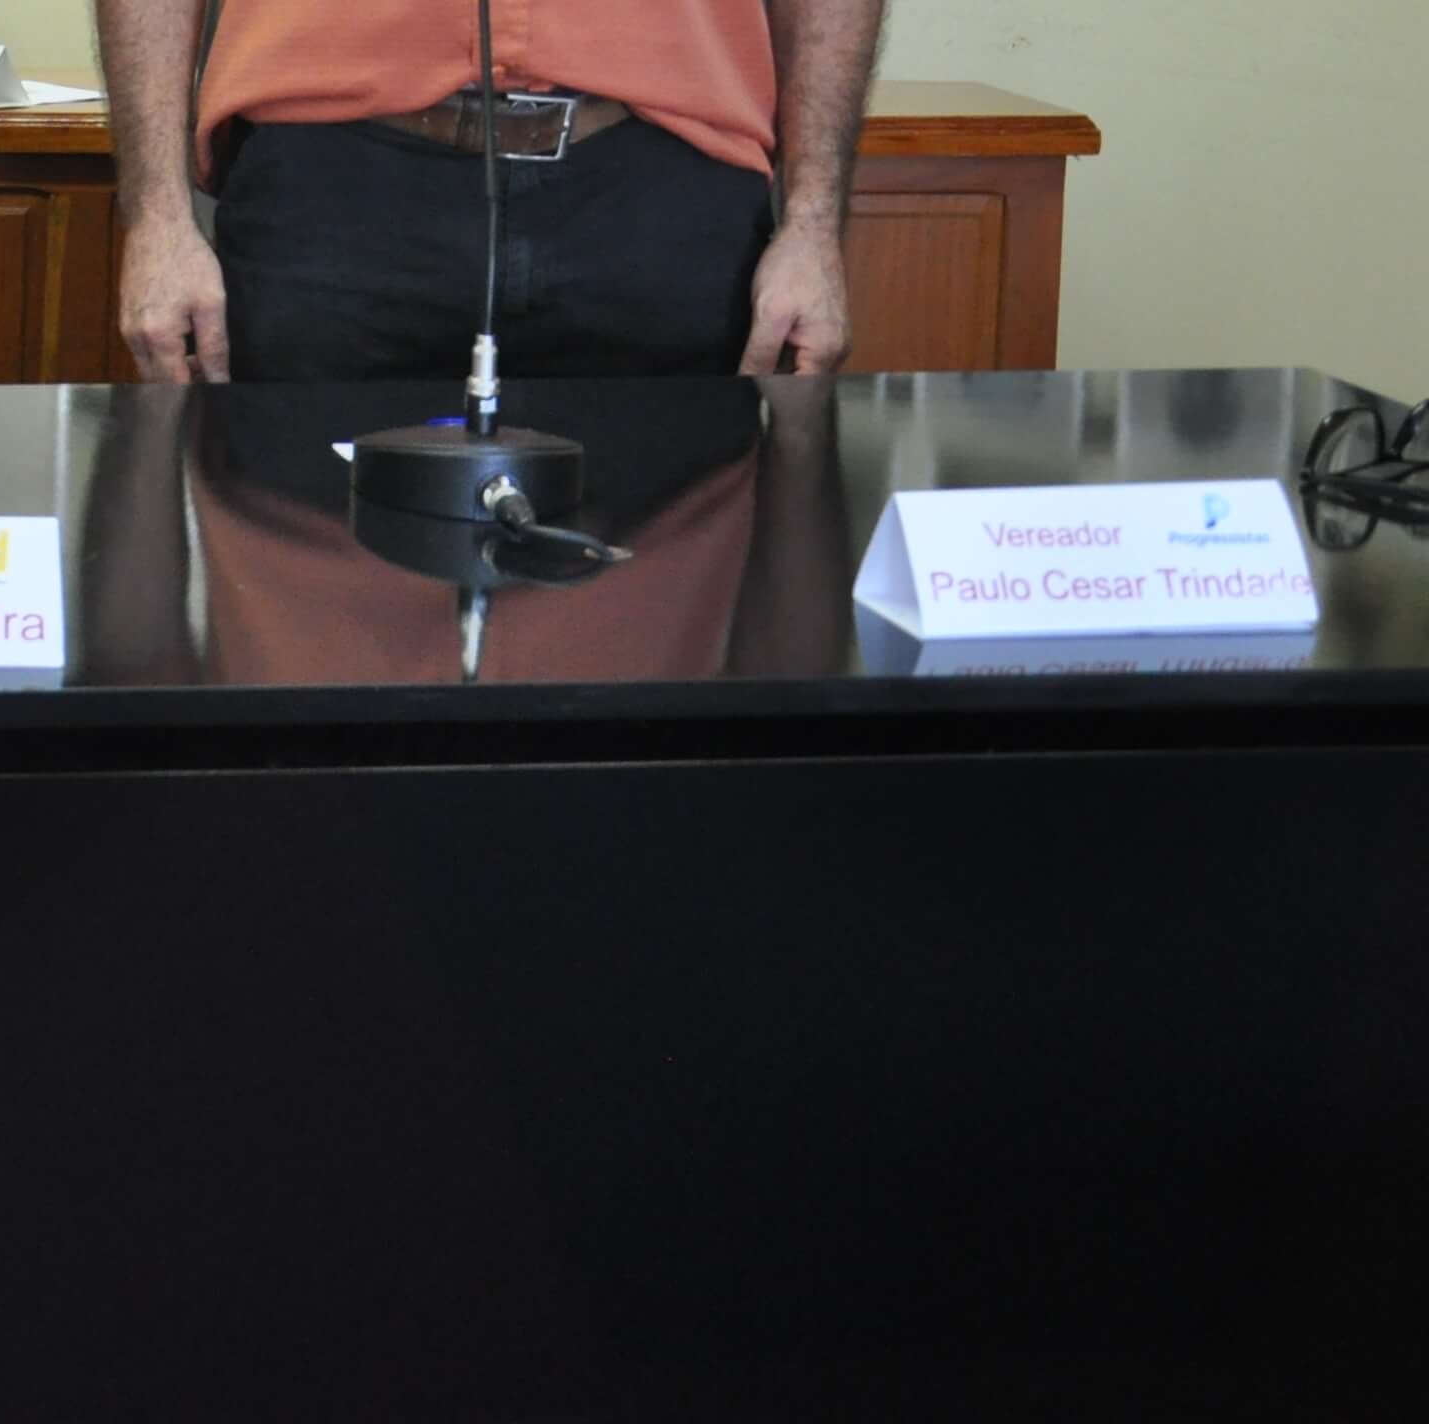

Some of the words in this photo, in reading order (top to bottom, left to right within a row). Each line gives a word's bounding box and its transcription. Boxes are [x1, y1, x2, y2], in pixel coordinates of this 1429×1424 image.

[982, 520, 1123, 549] Vereador
[929, 570, 1031, 602] Paulo
[1042, 568, 1147, 601] Cesar
[1155, 566, 1314, 598] Trindade
